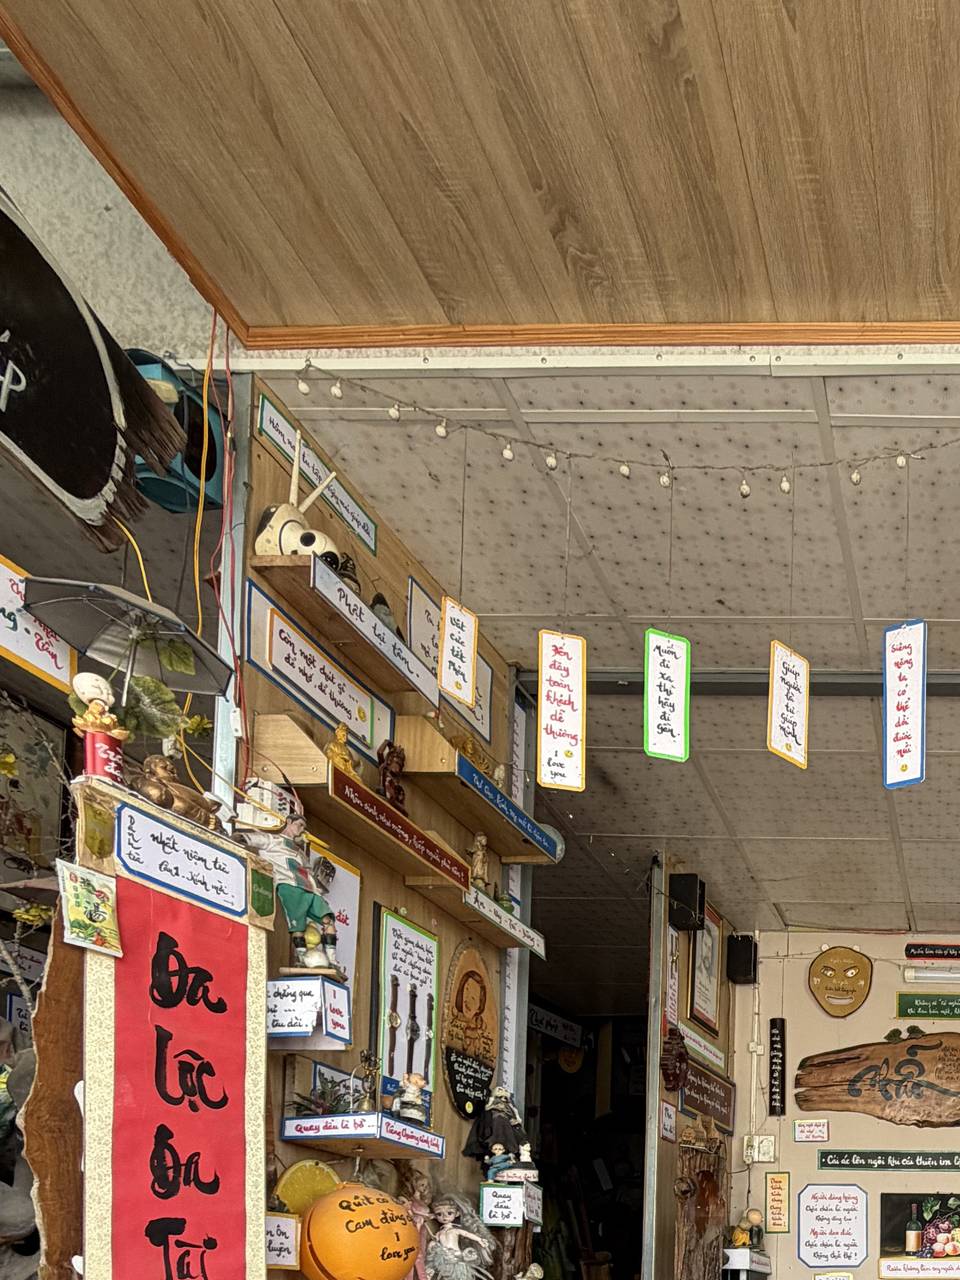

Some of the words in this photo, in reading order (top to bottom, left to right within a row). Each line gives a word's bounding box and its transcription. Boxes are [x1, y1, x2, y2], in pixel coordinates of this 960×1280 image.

[337, 588, 364, 622] Phật
[373, 623, 385, 645] tại
[279, 629, 297, 656] Còn
[299, 649, 317, 670] một
[549, 660, 569, 677] đây
[660, 659, 670, 669] đi
[659, 672, 673, 682] xa
[546, 677, 573, 692] toàn
[656, 682, 675, 696] thì
[658, 696, 675, 712] hãy
[550, 710, 565, 723] dễ
[660, 711, 670, 721] đi
[331, 1019, 346, 1030] you
[154, 1024, 229, 1113] Lộc
[295, 1124, 320, 1134] Quay
[323, 1120, 338, 1130] đầu
[341, 1120, 349, 1128] là
[827, 1154, 839, 1164] Cái
[853, 1155, 865, 1164] lên
[868, 1156, 885, 1167] ngôi
[888, 1156, 900, 1165] khi
[902, 1154, 913, 1165] cái
[916, 1155, 937, 1167] thiện
[940, 1156, 951, 1165] im
[346, 1219, 379, 1232] Cam
